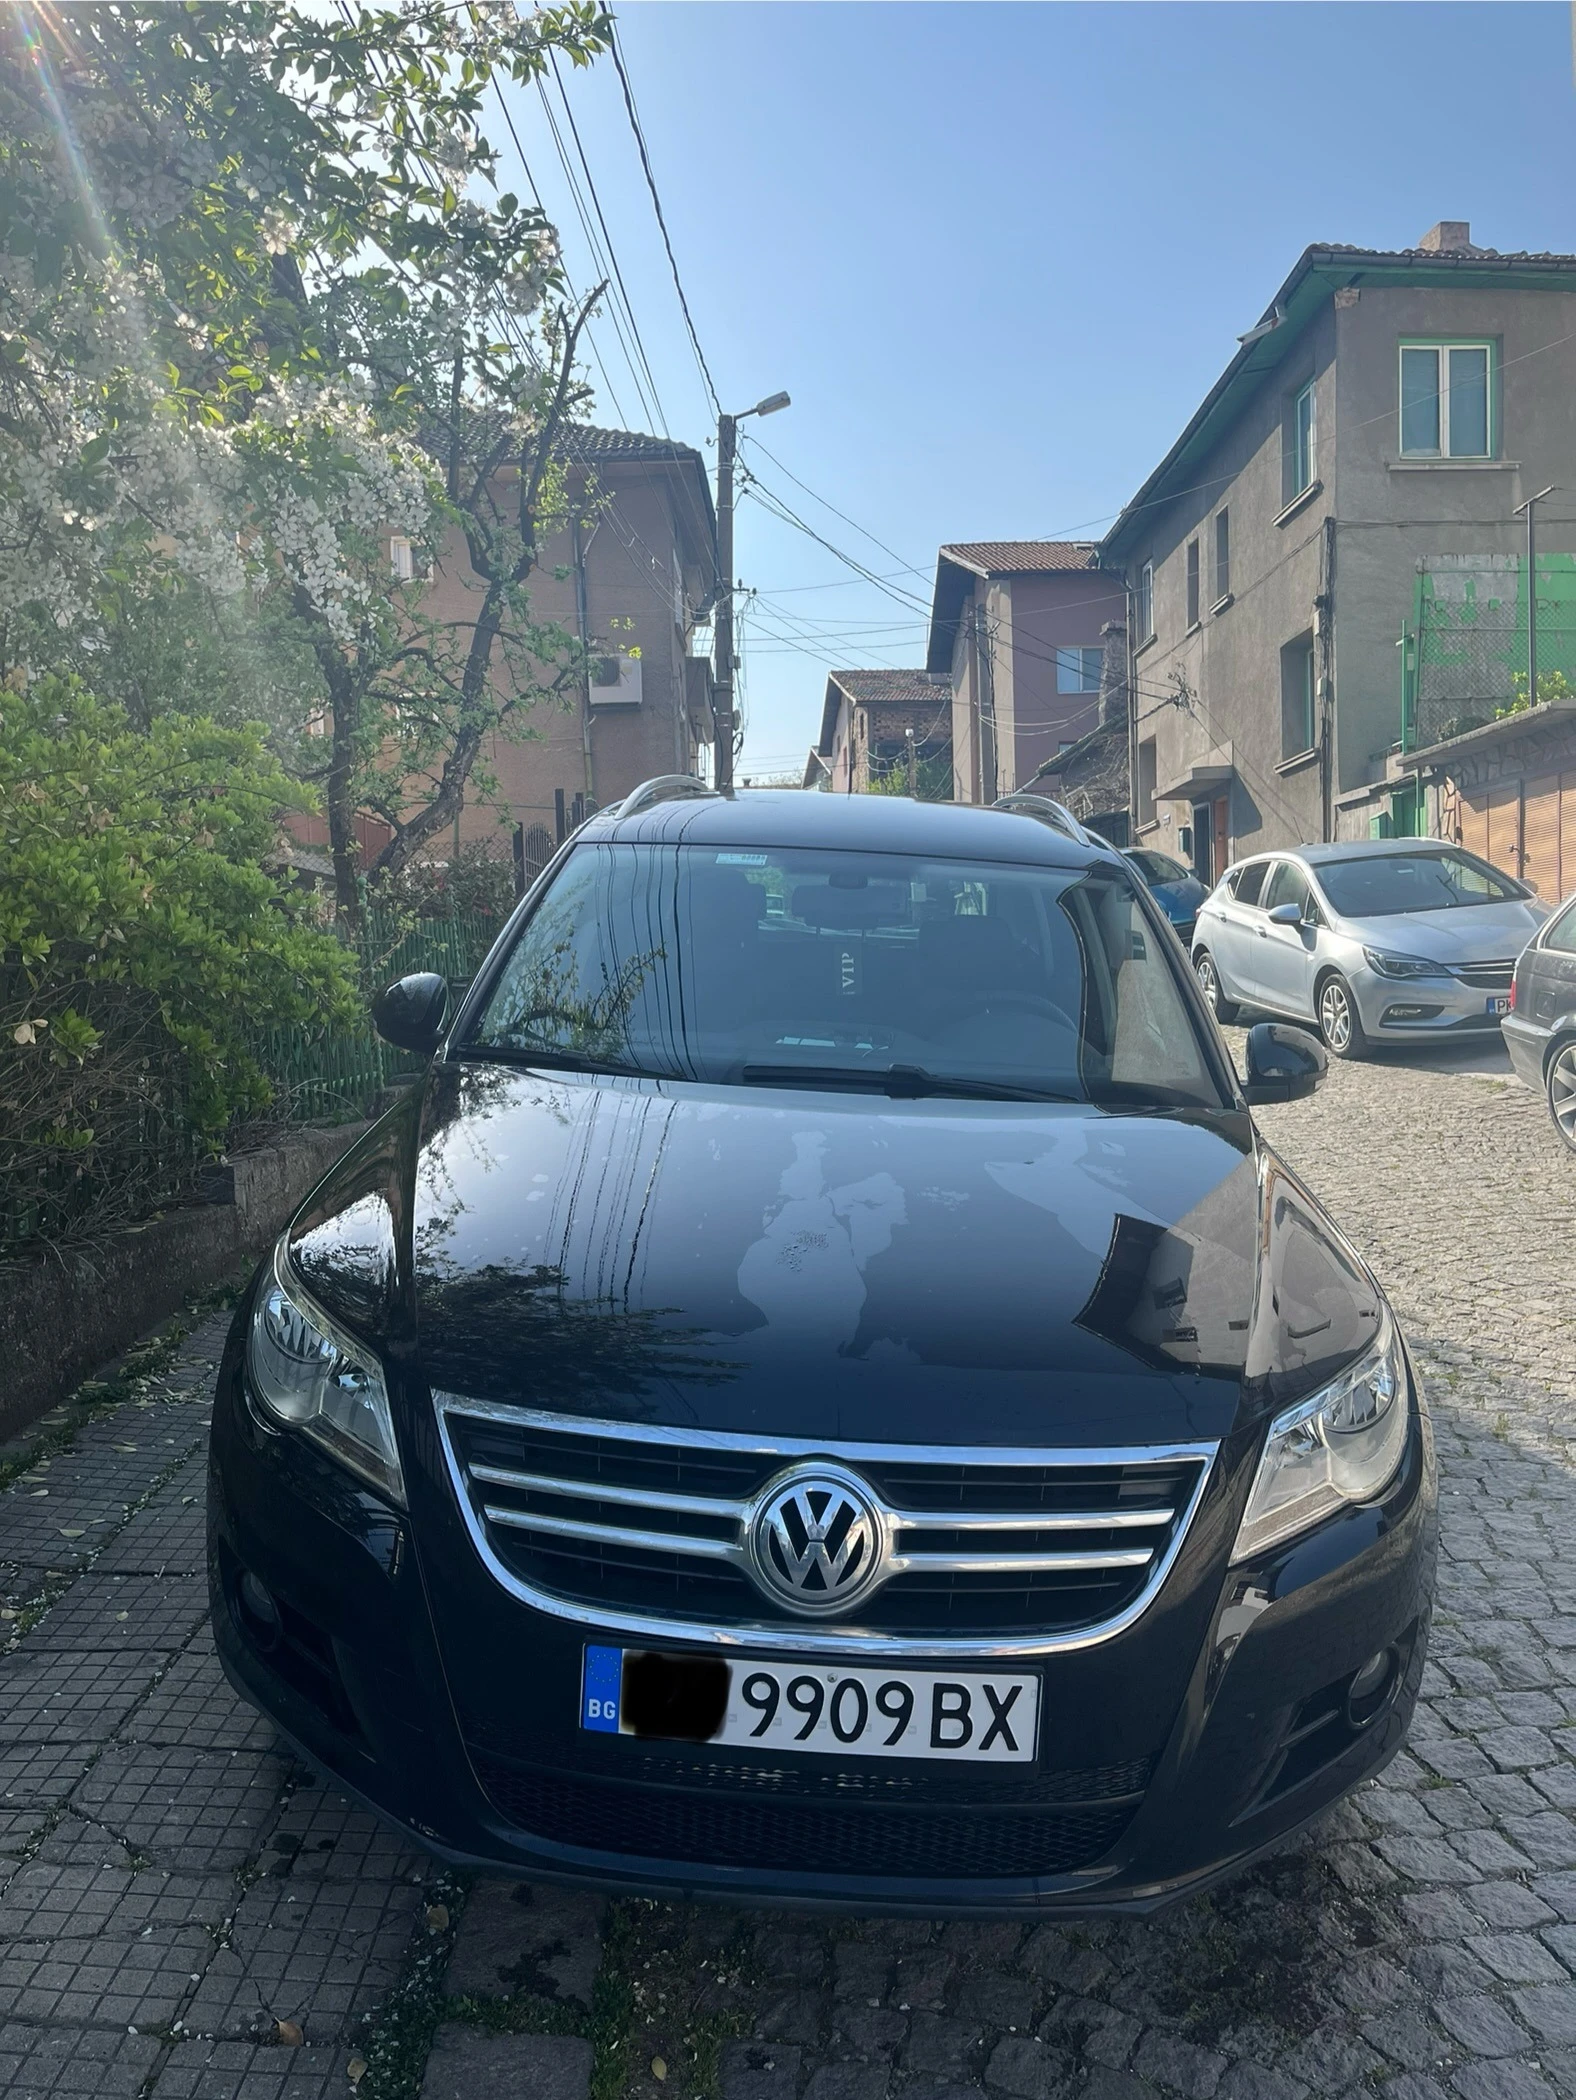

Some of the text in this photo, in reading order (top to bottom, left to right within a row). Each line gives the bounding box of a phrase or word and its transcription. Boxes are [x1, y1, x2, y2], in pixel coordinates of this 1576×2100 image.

[588, 1698, 616, 1720] BG
[741, 1672, 1023, 1752] 9909 BX
